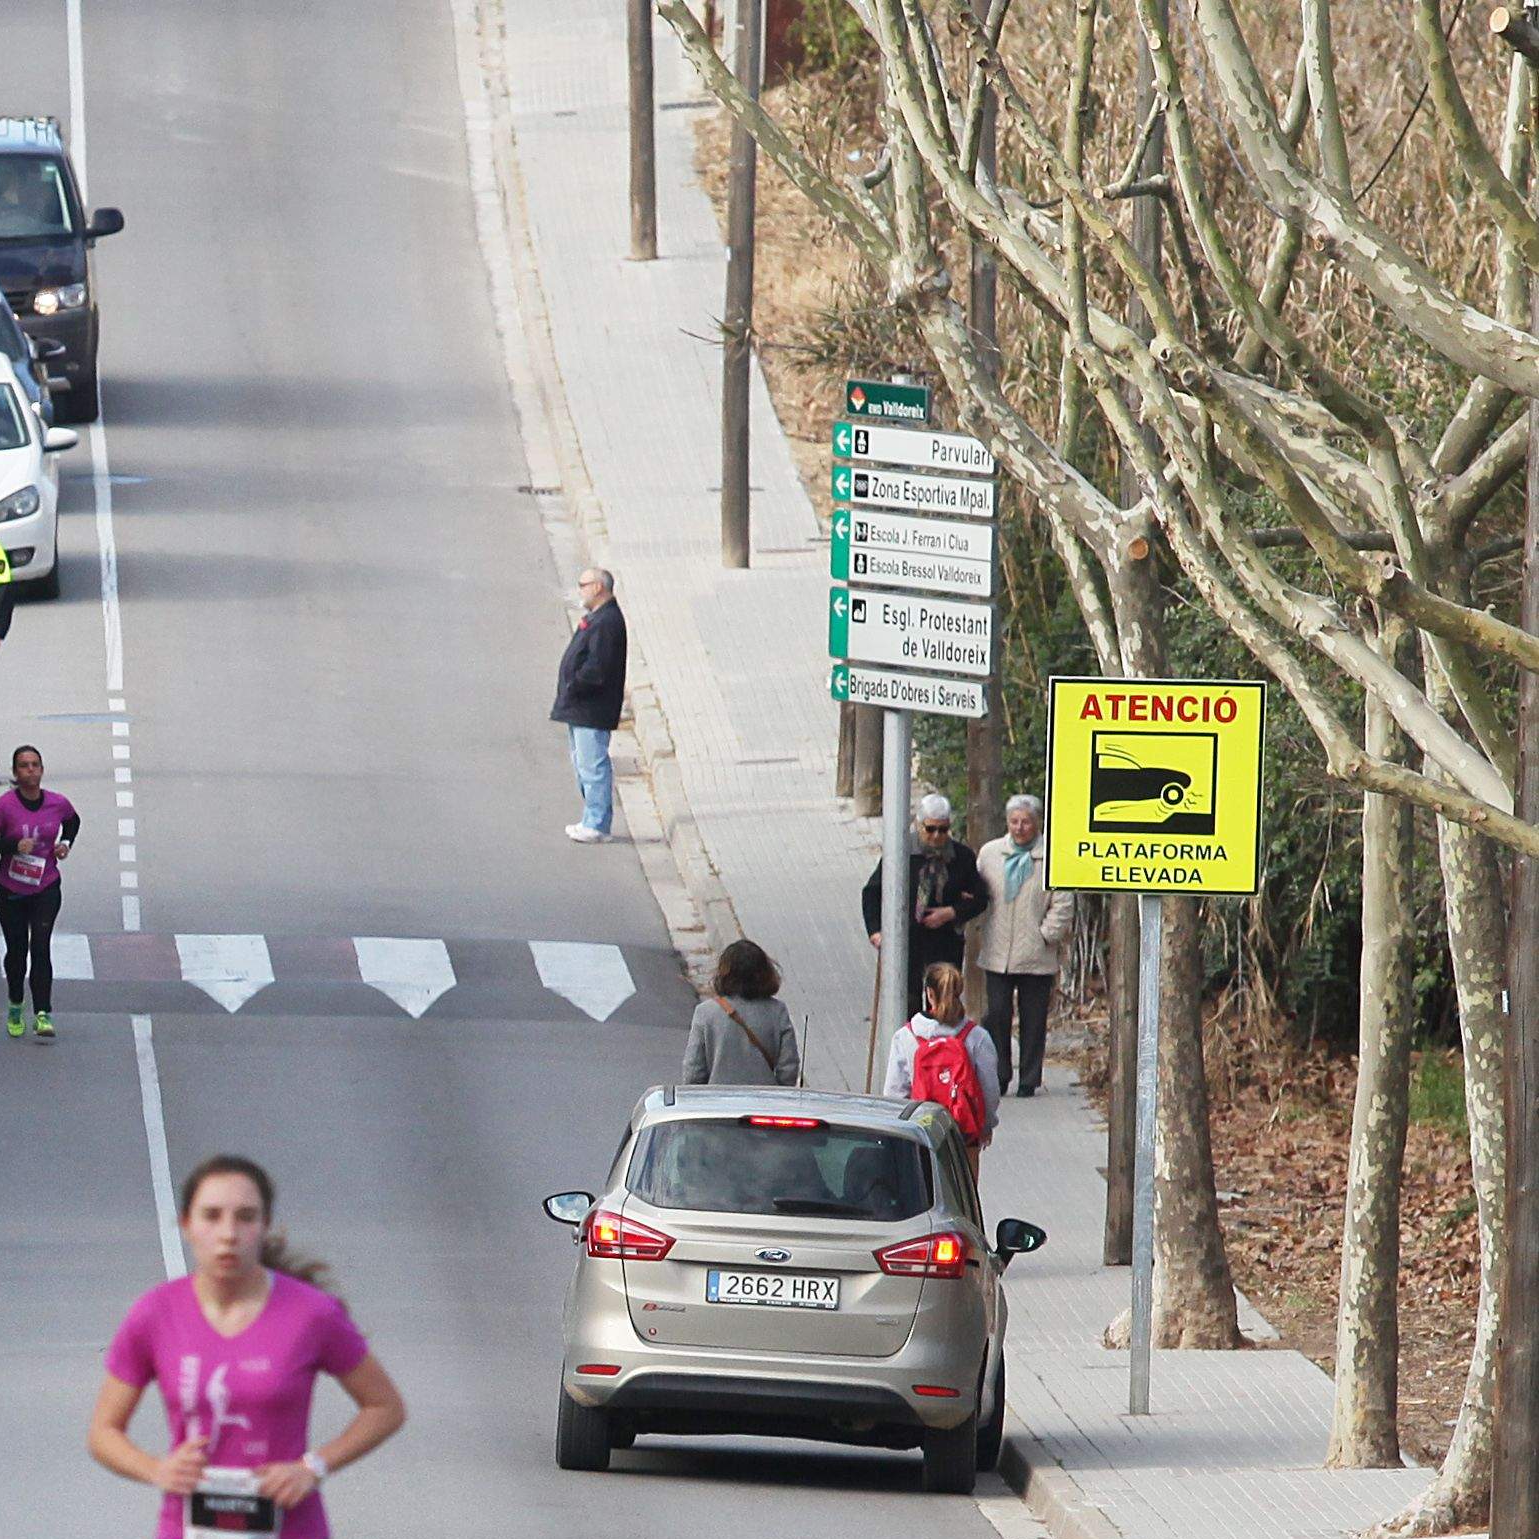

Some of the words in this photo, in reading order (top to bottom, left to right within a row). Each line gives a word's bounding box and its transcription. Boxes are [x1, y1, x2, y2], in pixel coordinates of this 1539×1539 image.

[872, 477, 900, 500] Zona
[904, 481, 956, 507] Esportiva
[960, 486, 990, 514] Mpal.
[871, 526, 900, 543] Escola
[902, 529, 910, 544] J.
[912, 530, 941, 547] Ferran
[948, 534, 969, 551] Clua
[870, 557, 900, 575] Escola
[902, 561, 936, 579] Bressol
[937, 565, 982, 585] Valldoreix
[883, 603, 915, 631] Esgl.
[920, 608, 988, 636] Protestant
[902, 636, 918, 657] de
[922, 638, 987, 665] Valldoreix
[850, 674, 888, 701] Brigada
[891, 679, 930, 704] D'obres
[938, 684, 976, 709] Serveis
[1080, 689, 1237, 724] ATENCIÓ
[1078, 841, 1228, 861] PLATAFORMA
[1101, 866, 1203, 884] ELEVADA
[726, 1275, 784, 1297] 2662
[792, 1279, 836, 1301] HRX
